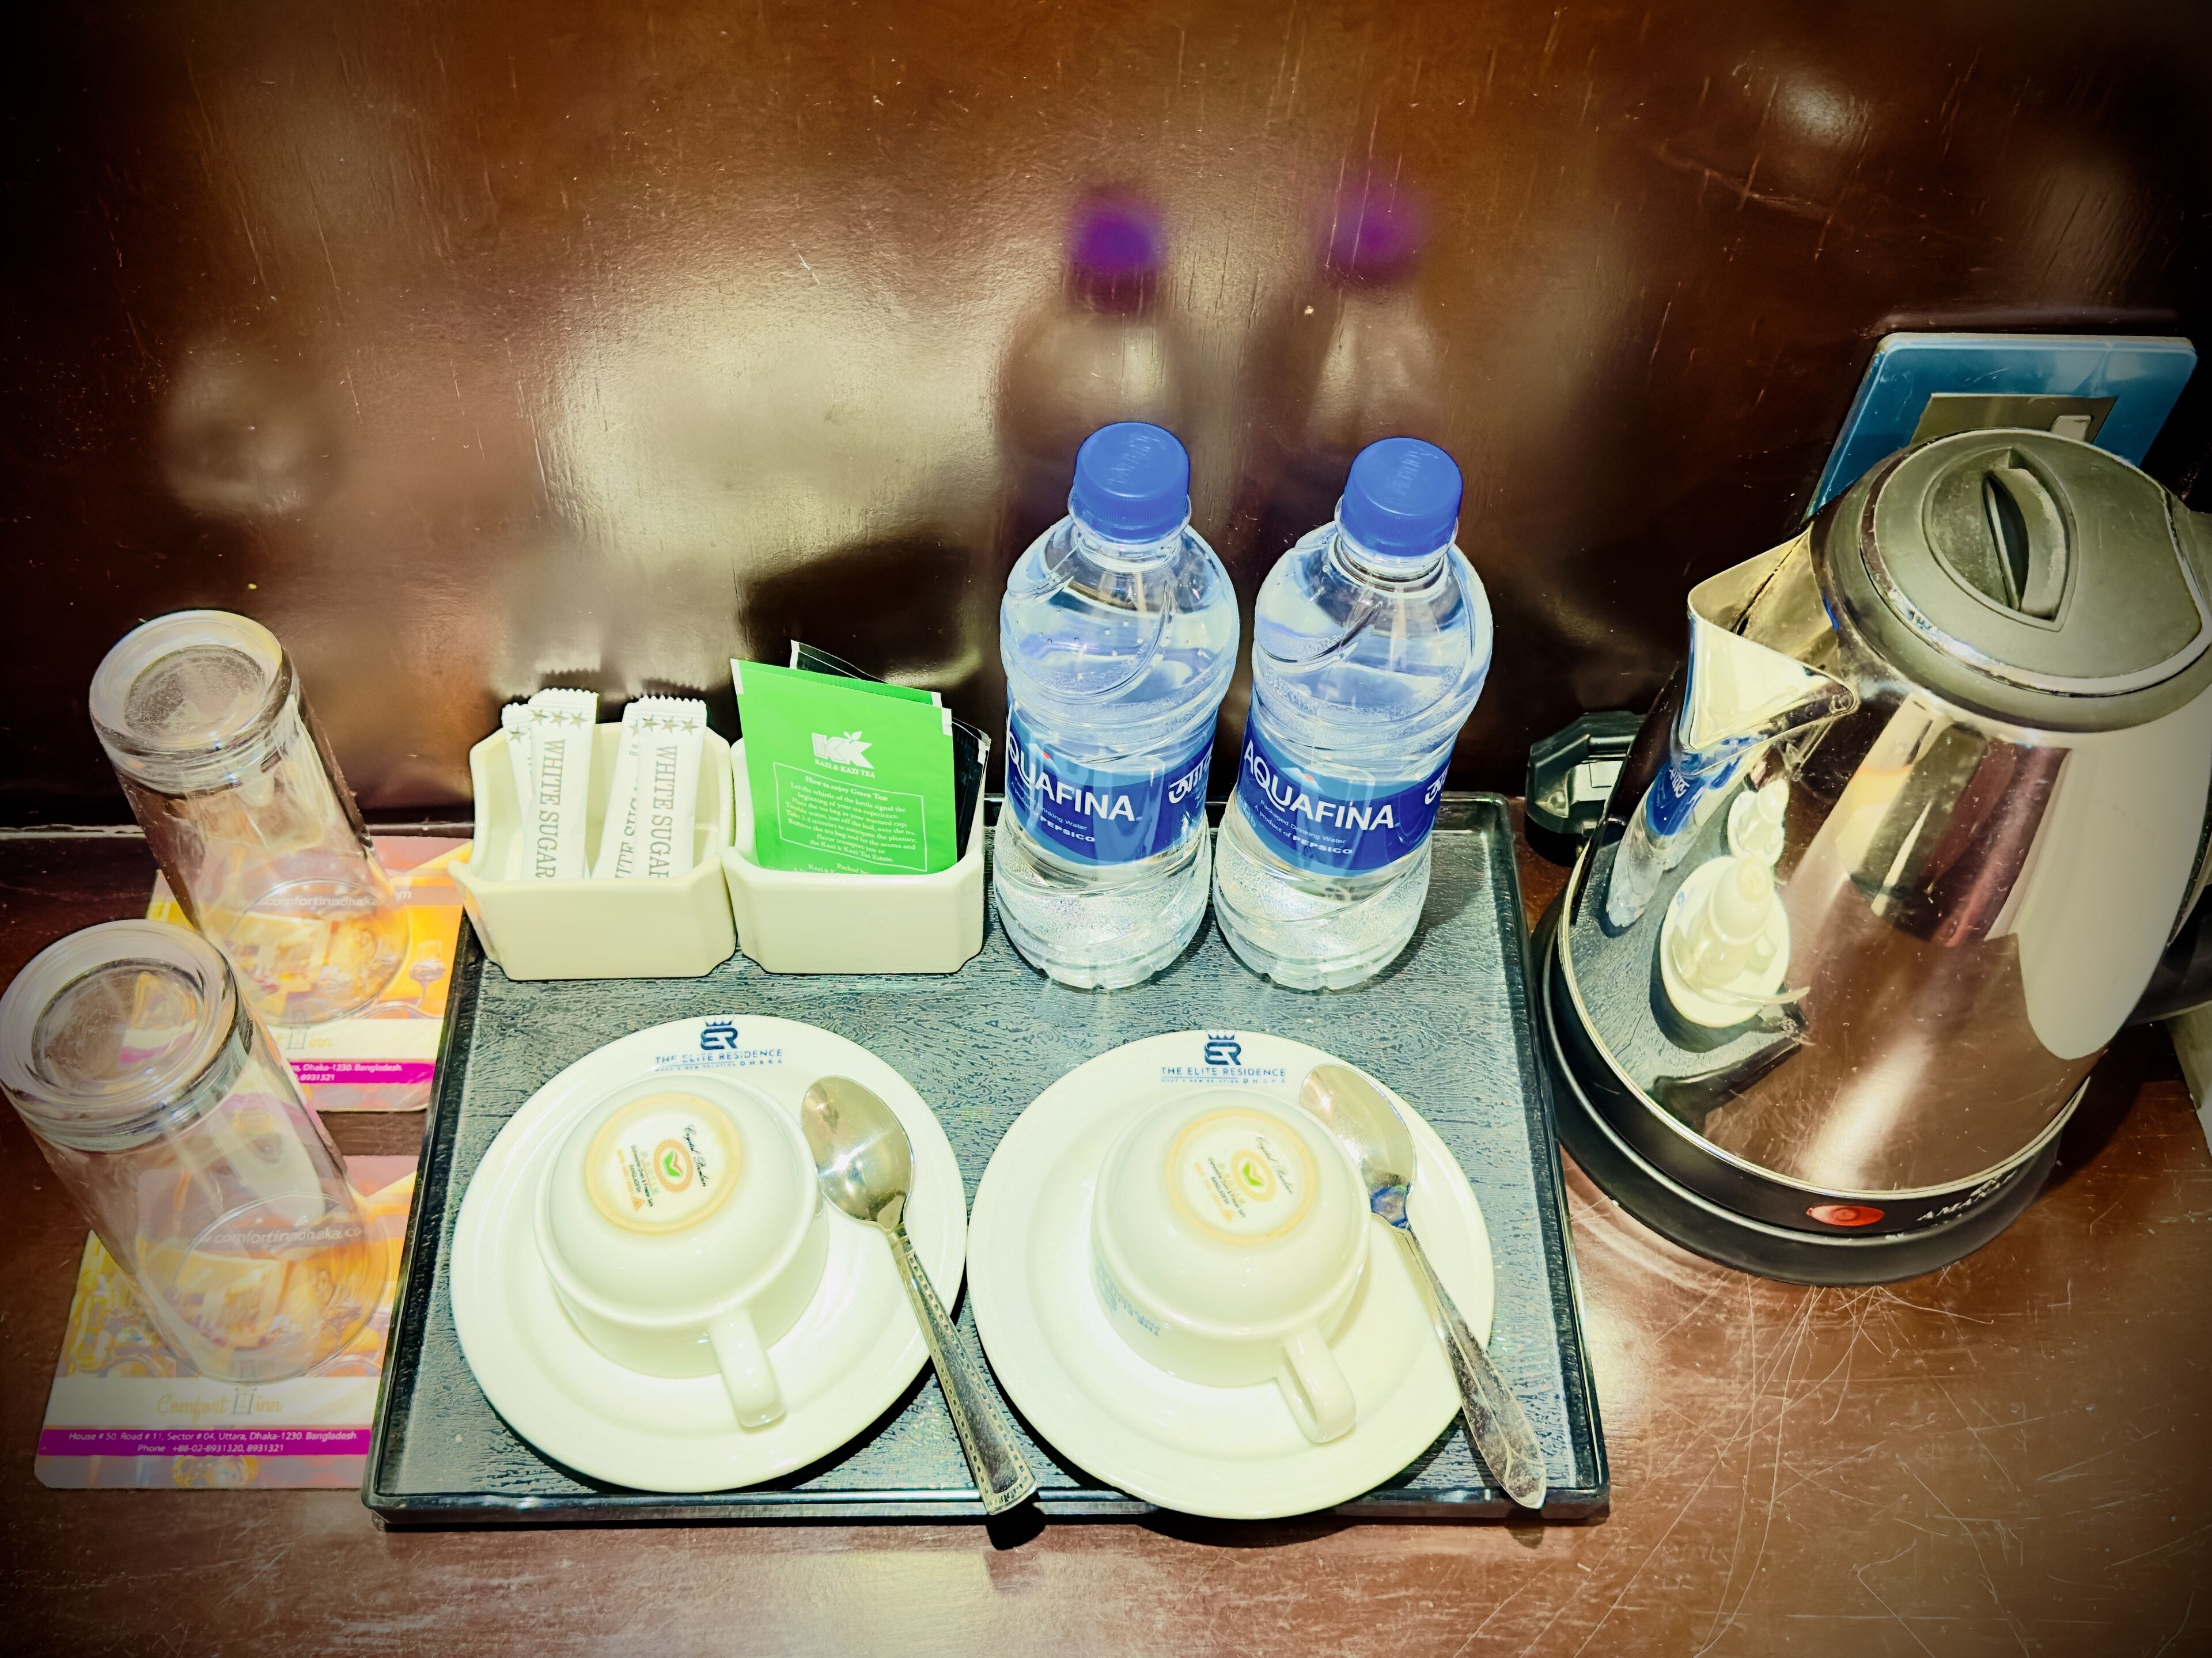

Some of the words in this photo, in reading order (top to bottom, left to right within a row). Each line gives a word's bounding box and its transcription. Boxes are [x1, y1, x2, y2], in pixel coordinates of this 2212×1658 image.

[539, 739, 565, 806] WHITE
[653, 745, 677, 810] WHITE
[815, 758, 832, 769] KAZI
[840, 766, 859, 775] KAZI
[861, 769, 876, 778] TEA
[1008, 730, 1135, 822] QUAFINA
[805, 776, 821, 786] How
[831, 786, 849, 794] enjoy
[850, 788, 872, 798] Green
[1244, 739, 1395, 830] AQUAFINA
[792, 797, 807, 807] Place
[830, 807, 842, 816] bag
[866, 817, 892, 826] warmed
[798, 791, 828, 806] beginning
[863, 809, 899, 819] experience.
[813, 790, 835, 799] whistle
[855, 799, 873, 808] kettle
[874, 804, 893, 812] signal
[785, 809, 801, 818] Take
[812, 819, 838, 828] minutes
[888, 835, 918, 843] pleasure.
[788, 818, 812, 830] Remove
[835, 830, 847, 839] bag
[862, 823, 876, 832] boil,
[1040, 815, 1095, 842] PEPSICO
[1065, 819, 1088, 830] Water
[1260, 799, 1289, 826] Packaged
[1290, 824, 1320, 840] Drinking
[1322, 836, 1346, 844] Water
[535, 809, 559, 878] SUGAR
[821, 841, 836, 849] Kazi
[844, 847, 858, 855] Kazi
[859, 850, 871, 858] Tea
[872, 854, 894, 862] Estate.
[836, 839, 864, 850] transport
[1293, 835, 1353, 854] PEPSICO
[656, 1054, 676, 1064] THE
[719, 1049, 782, 1060] RESIDENCE
[740, 1058, 783, 1067] DHAKA
[354, 1064, 403, 1073] Bangladesh.
[1161, 1067, 1181, 1075] THE
[1187, 1067, 1217, 1076] ELITE
[1223, 1068, 1286, 1076] RESIDENCE
[683, 1125, 700, 1155] Crystal
[694, 1156, 709, 1187] Porcelain
[629, 1164, 641, 1193] BANGLADESH
[1211, 1177, 1229, 1205] BANGLADESH
[157, 1393, 230, 1423] Comfort
[255, 1395, 282, 1413] inn
[69, 1432, 96, 1440] House
[106, 1432, 117, 1441] 50,
[120, 1432, 142, 1440] Road
[167, 1432, 195, 1441] Sector
[203, 1432, 216, 1441] 04,
[219, 1432, 247, 1441] Uttara,
[306, 1431, 358, 1442] Bangladesh.
[138, 1444, 166, 1452] Phone
[247, 1444, 284, 1452] 8931321
